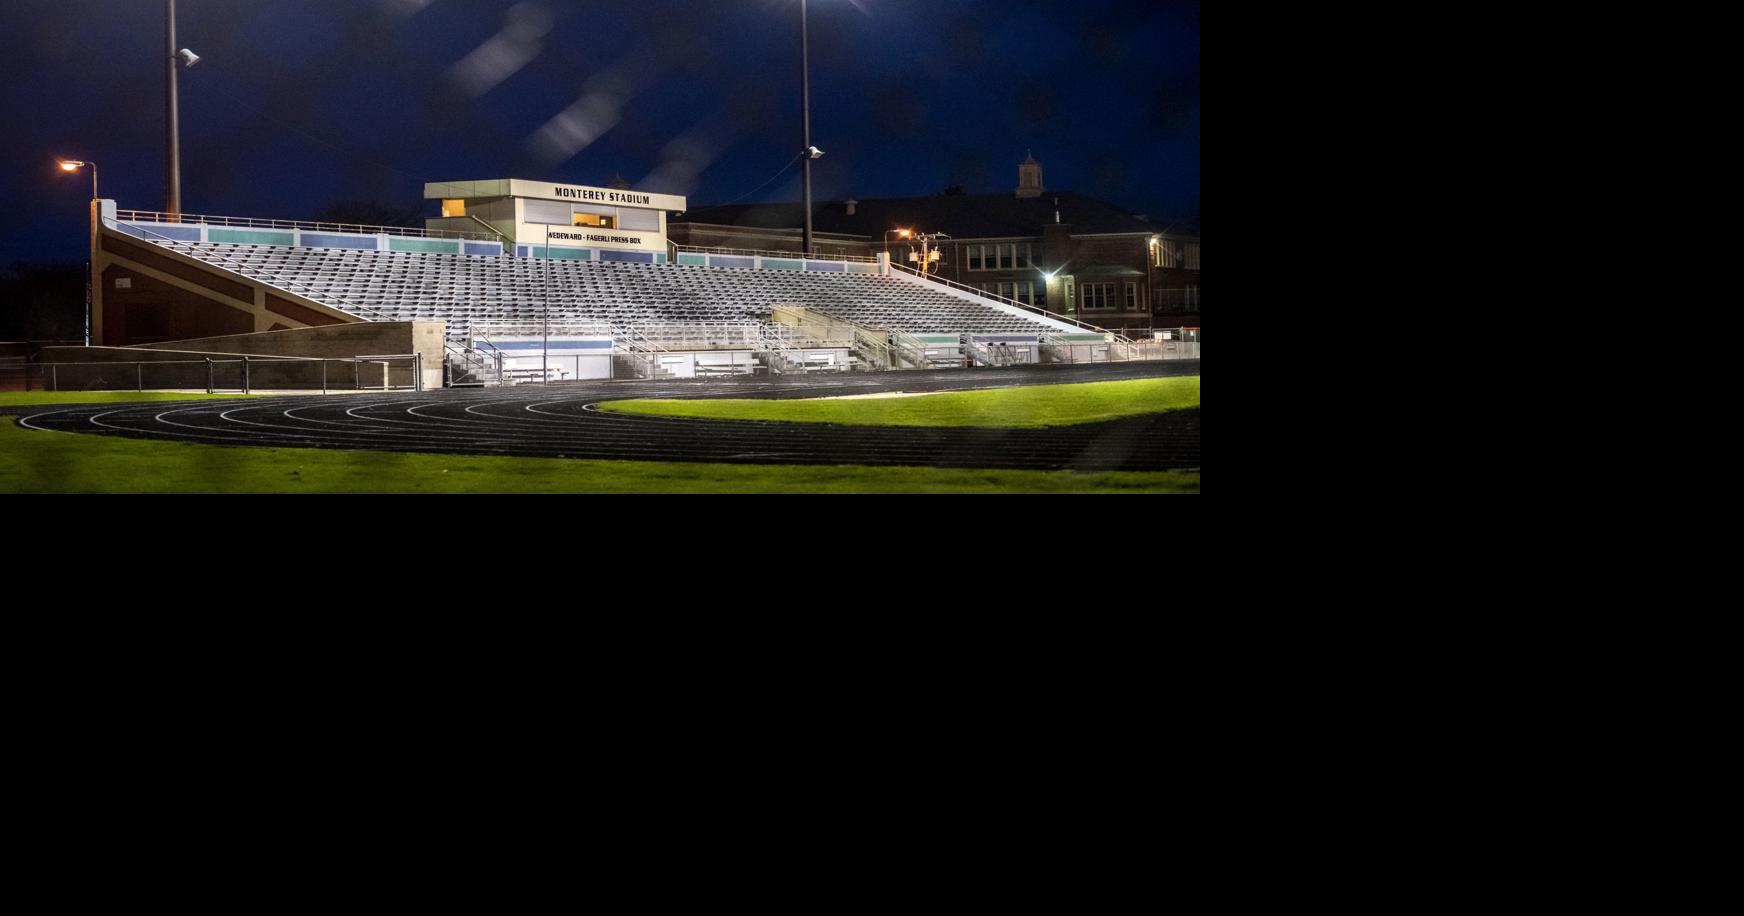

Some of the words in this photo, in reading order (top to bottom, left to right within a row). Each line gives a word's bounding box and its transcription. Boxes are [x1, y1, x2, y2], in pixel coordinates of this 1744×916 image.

[555, 187, 605, 200] MONTEREY
[609, 192, 650, 204] STADIUM
[586, 234, 610, 242] FAGERLI
